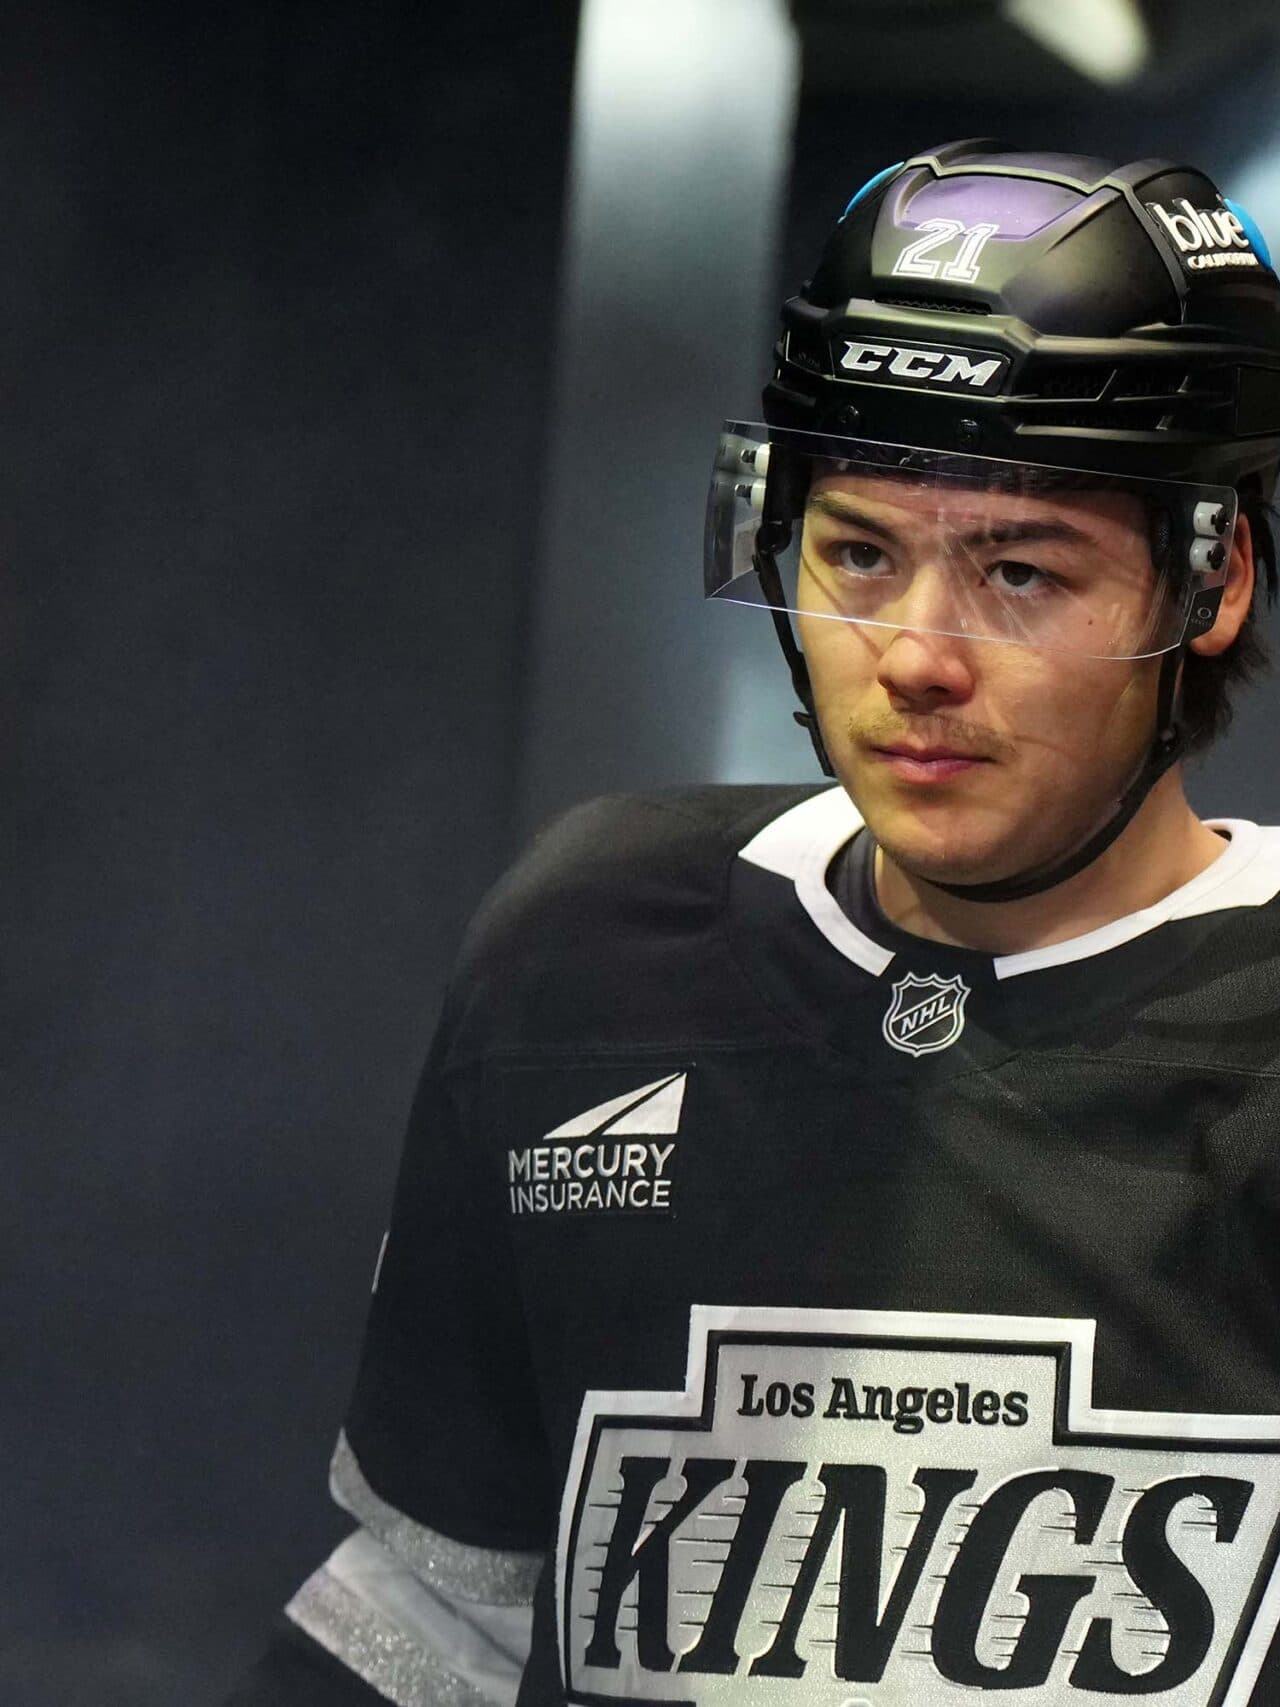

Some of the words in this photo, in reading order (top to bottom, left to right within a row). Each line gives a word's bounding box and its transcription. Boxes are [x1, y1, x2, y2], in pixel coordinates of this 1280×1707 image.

[1150, 198, 1249, 252] blue
[892, 217, 1000, 284] 21
[840, 341, 1001, 387] CCM
[900, 996, 951, 1036] NHL
[508, 1143, 676, 1183] MERCURY
[510, 1180, 672, 1214] INSURANCE
[738, 1374, 814, 1418] Los
[822, 1377, 1028, 1434] Angeles
[584, 1456, 1255, 1694] KINGS
